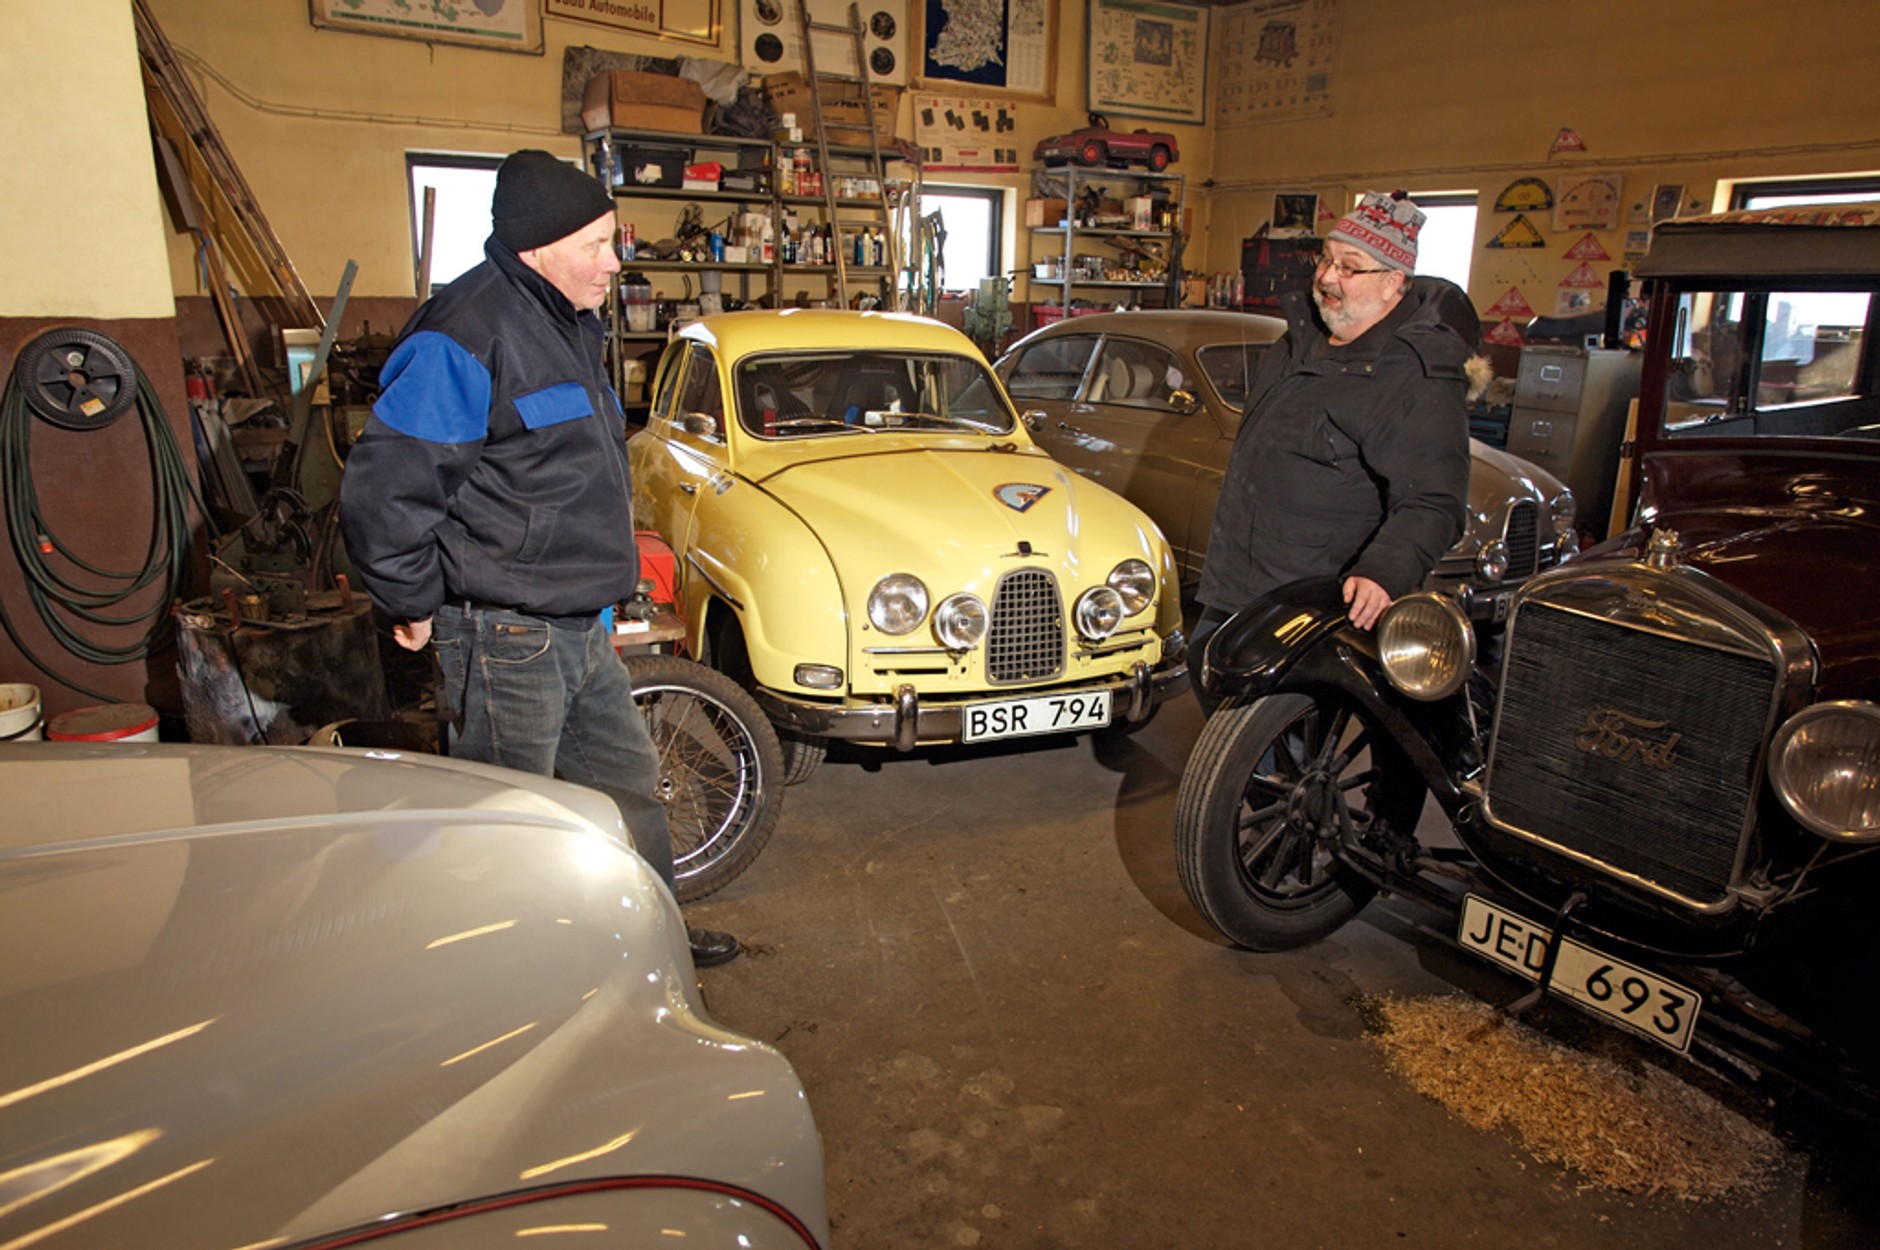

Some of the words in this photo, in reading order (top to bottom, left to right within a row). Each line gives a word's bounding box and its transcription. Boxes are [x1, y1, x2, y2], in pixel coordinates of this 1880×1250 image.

[589, 0, 655, 22] Automobile
[970, 704, 1028, 737] BSR
[1049, 697, 1105, 726] 794
[1576, 708, 1681, 769] Ford
[1469, 912, 1549, 973] JED
[1586, 965, 1686, 1035] 693
